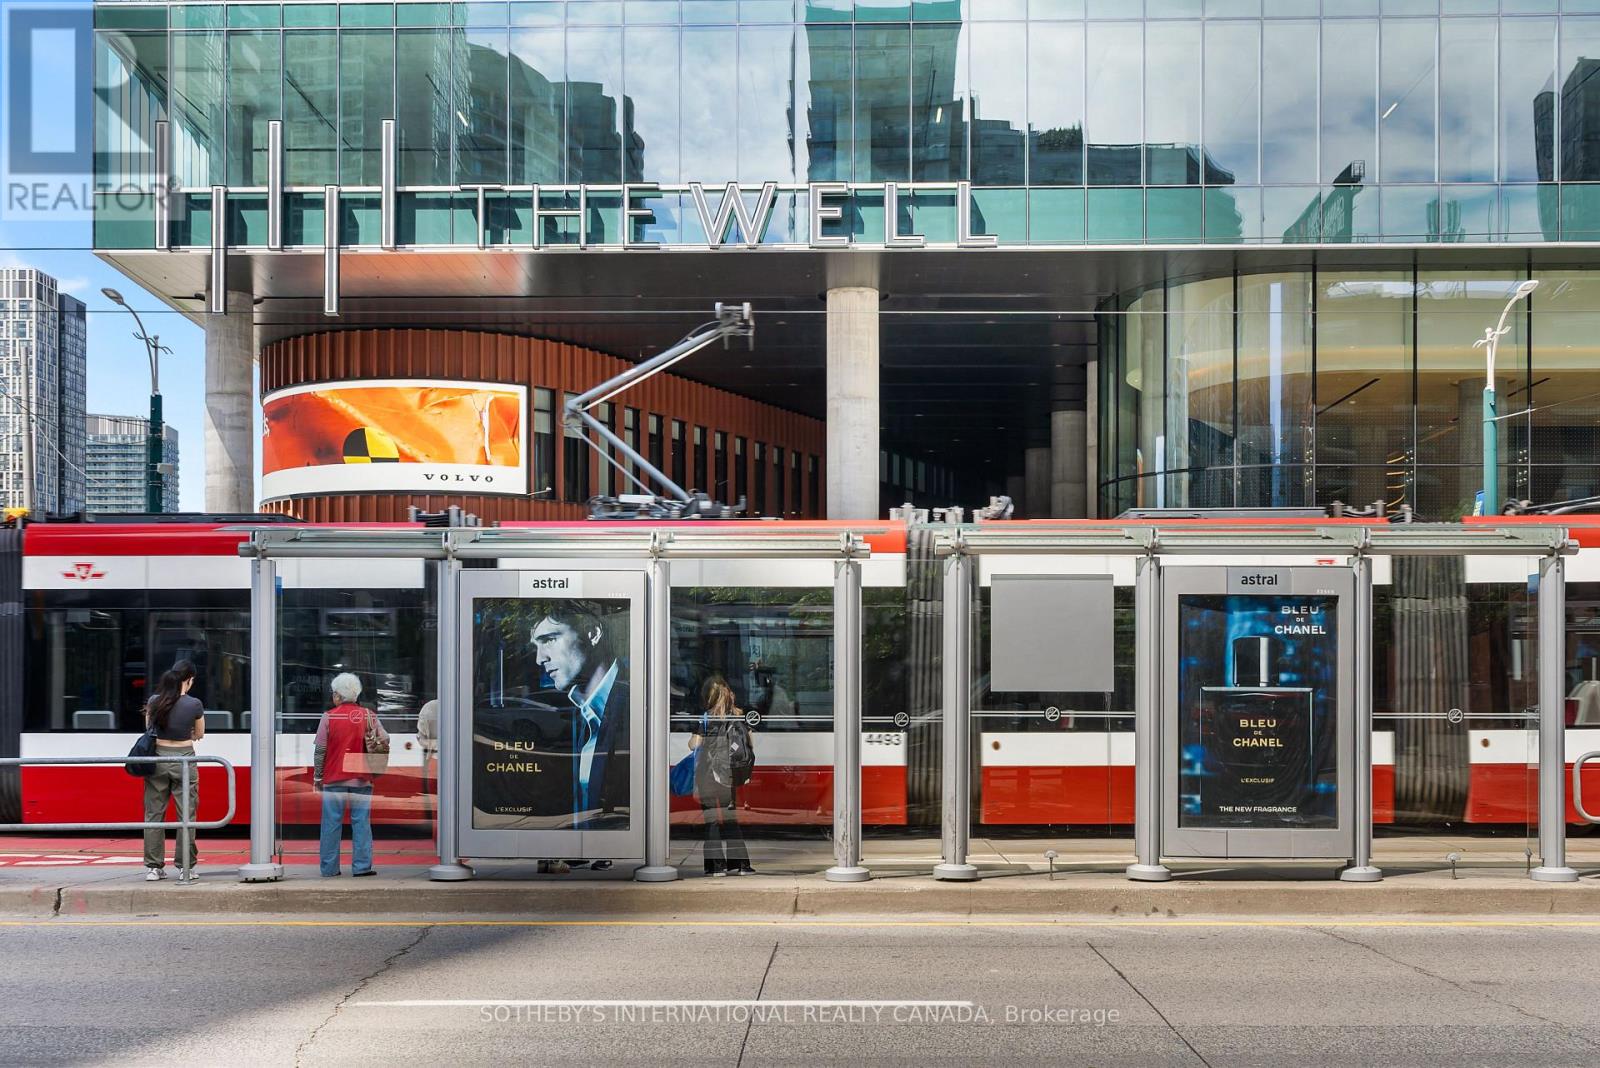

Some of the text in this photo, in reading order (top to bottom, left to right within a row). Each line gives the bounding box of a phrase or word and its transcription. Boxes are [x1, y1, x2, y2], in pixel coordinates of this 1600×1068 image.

[459, 181, 998, 250] THE WELL
[424, 473, 494, 483] VOLVO
[532, 577, 569, 589] astral
[1241, 574, 1278, 586] astral
[1281, 605, 1319, 615] BLEU
[1274, 625, 1326, 635] CHANEL
[1239, 719, 1277, 728] BLEU
[494, 741, 535, 751] BLEU
[1233, 738, 1284, 748] CHANEL
[486, 762, 542, 773] CHANEL
[1253, 806, 1297, 814] FRAGRANCE
